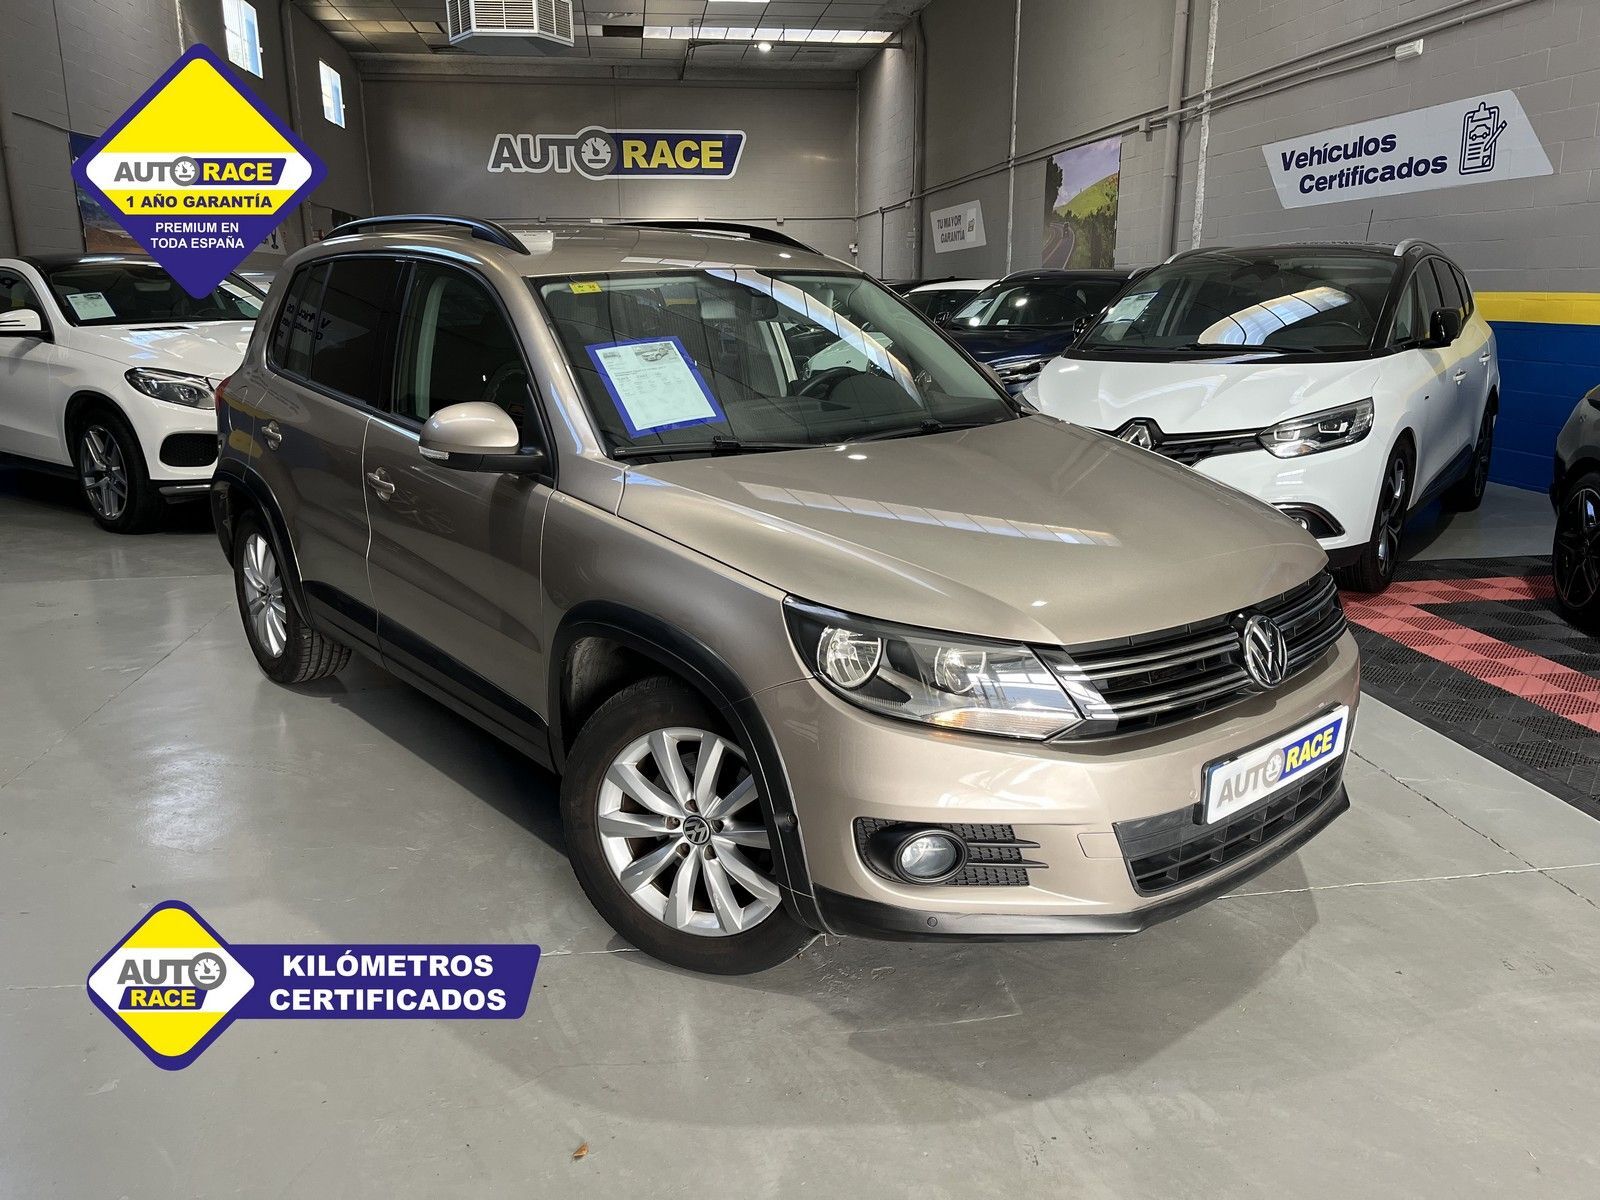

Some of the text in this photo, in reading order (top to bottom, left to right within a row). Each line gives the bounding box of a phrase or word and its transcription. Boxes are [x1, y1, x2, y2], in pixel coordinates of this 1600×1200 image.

[622, 140, 724, 169] RACE
[1281, 134, 1397, 171] Vehículos
[1300, 155, 1448, 194] Certificados
[1285, 726, 1335, 774] RACE
